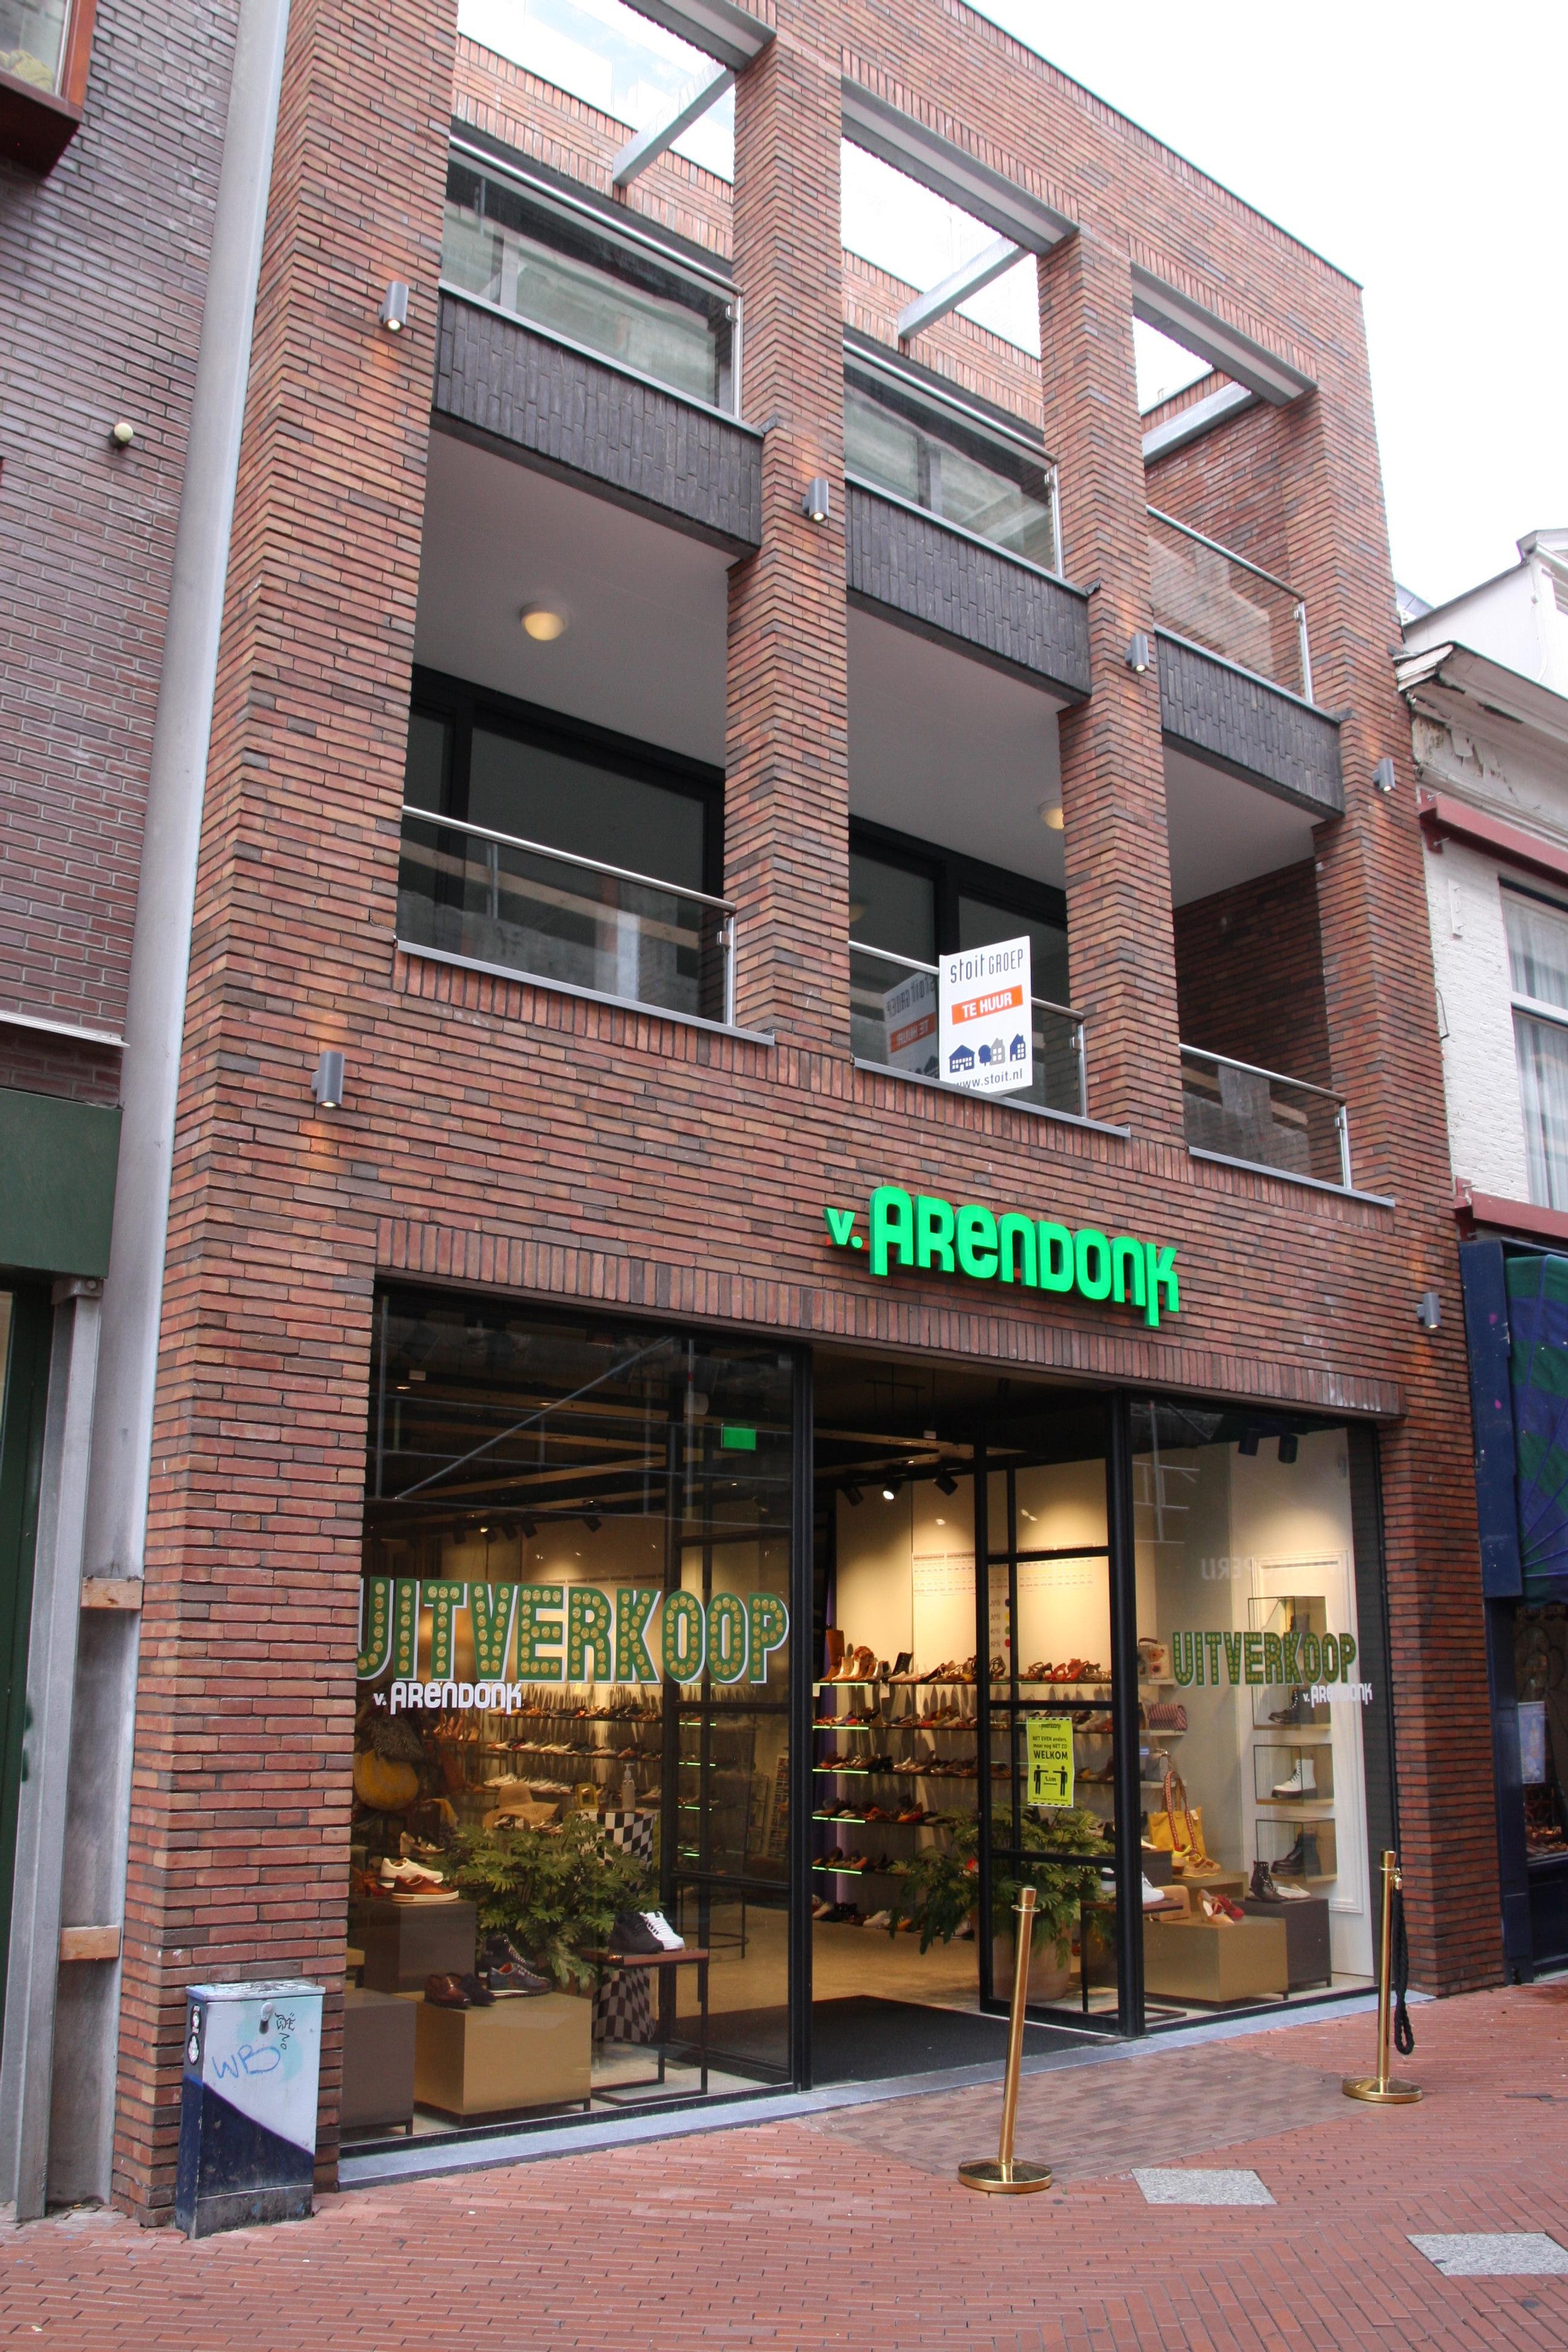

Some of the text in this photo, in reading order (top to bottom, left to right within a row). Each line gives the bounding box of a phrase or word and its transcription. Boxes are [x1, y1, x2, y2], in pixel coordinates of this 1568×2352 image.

[951, 949, 1023, 984] stoit GROEP
[962, 992, 1013, 1019] TE HUUR
[357, 1577, 790, 1684] UITVERKOOP
[1172, 1631, 1357, 1687] UITVERKOOP
[1033, 1750, 1068, 1760] WELKOM
